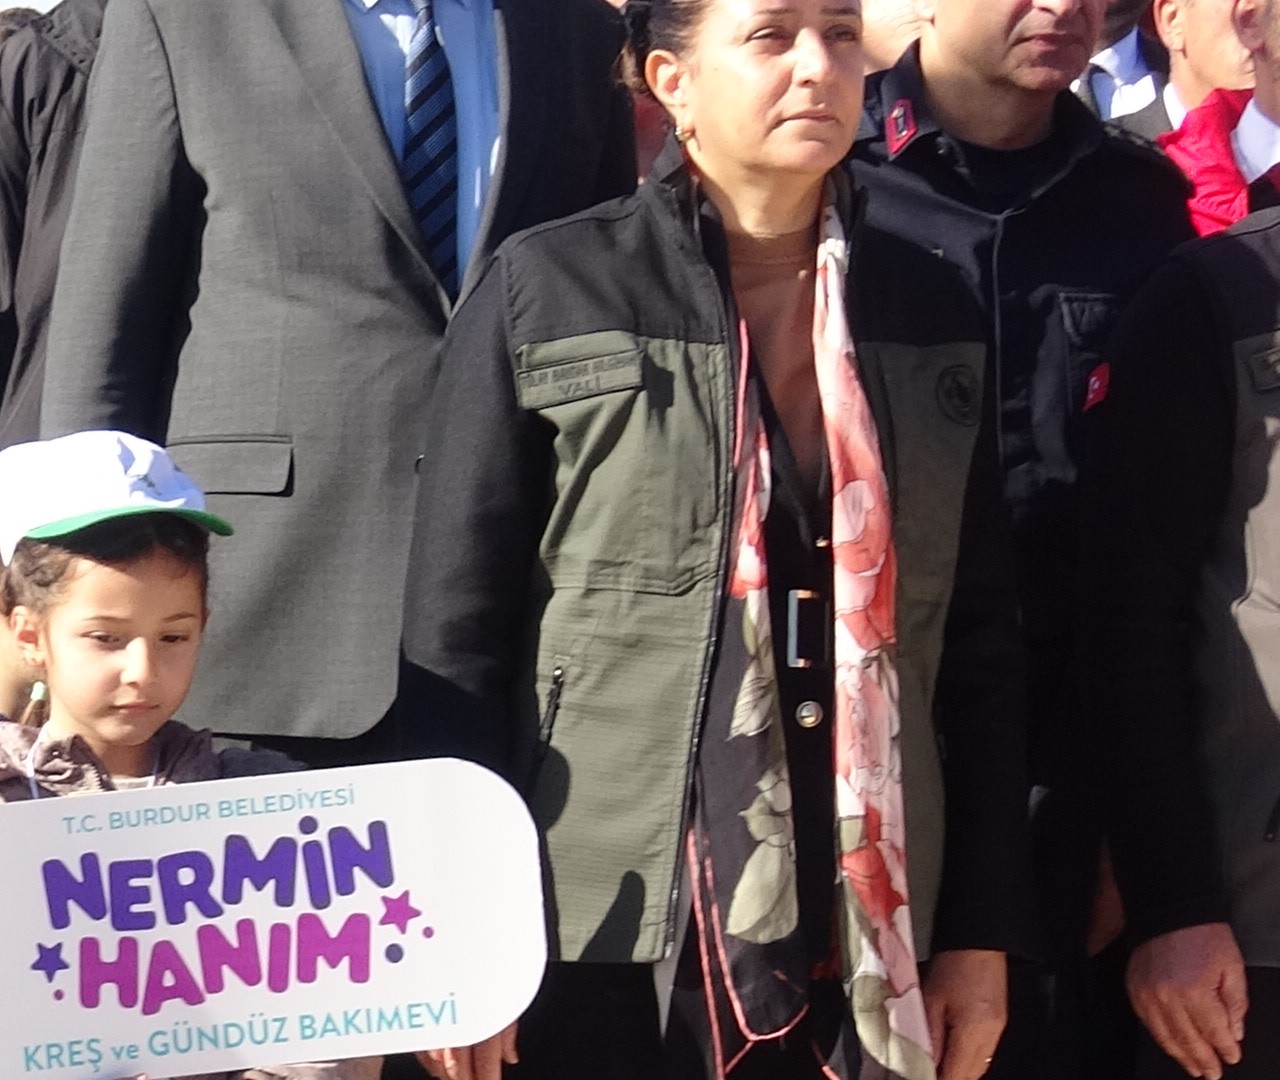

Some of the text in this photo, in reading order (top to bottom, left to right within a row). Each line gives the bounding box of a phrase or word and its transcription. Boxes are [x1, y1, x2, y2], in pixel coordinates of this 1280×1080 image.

[63, 784, 355, 834] T.C. BURDUR BELEDİYESİ
[42, 816, 395, 931] NERMİN
[79, 912, 370, 1015] HANIM
[23, 993, 458, 1073] KREŞ ve GÜNDÜZ BAKIMEVİ
